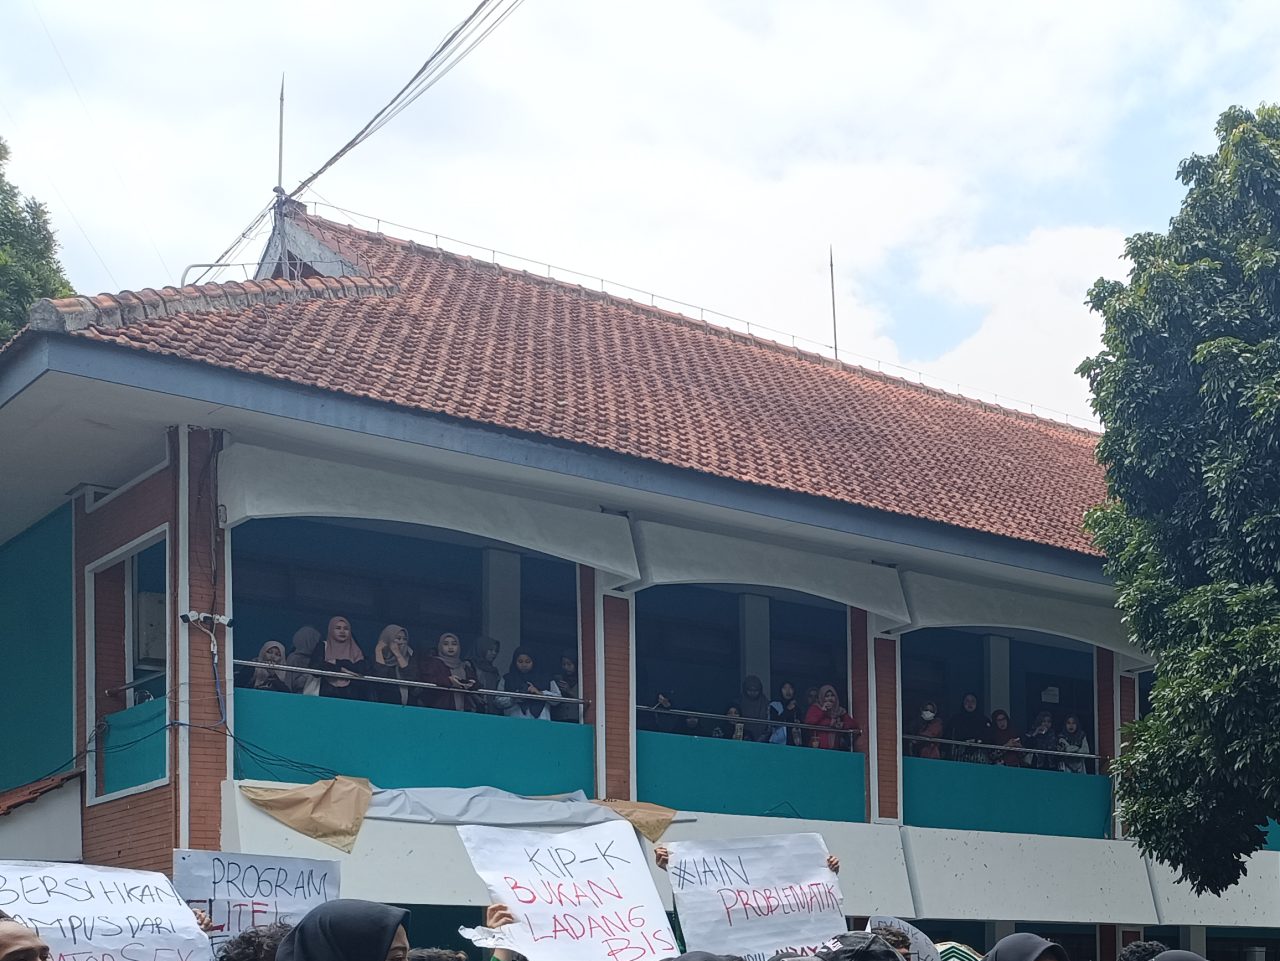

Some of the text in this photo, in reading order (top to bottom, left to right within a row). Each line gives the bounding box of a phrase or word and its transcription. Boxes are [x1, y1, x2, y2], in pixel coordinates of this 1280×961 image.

[524, 840, 631, 879] KIP-K
[212, 857, 328, 902] PROGRAM
[504, 877, 623, 908] BUKAN
[525, 905, 646, 943] LADANG
[717, 883, 843, 927] PROBLEMATIK
[126, 915, 177, 939] DARI
